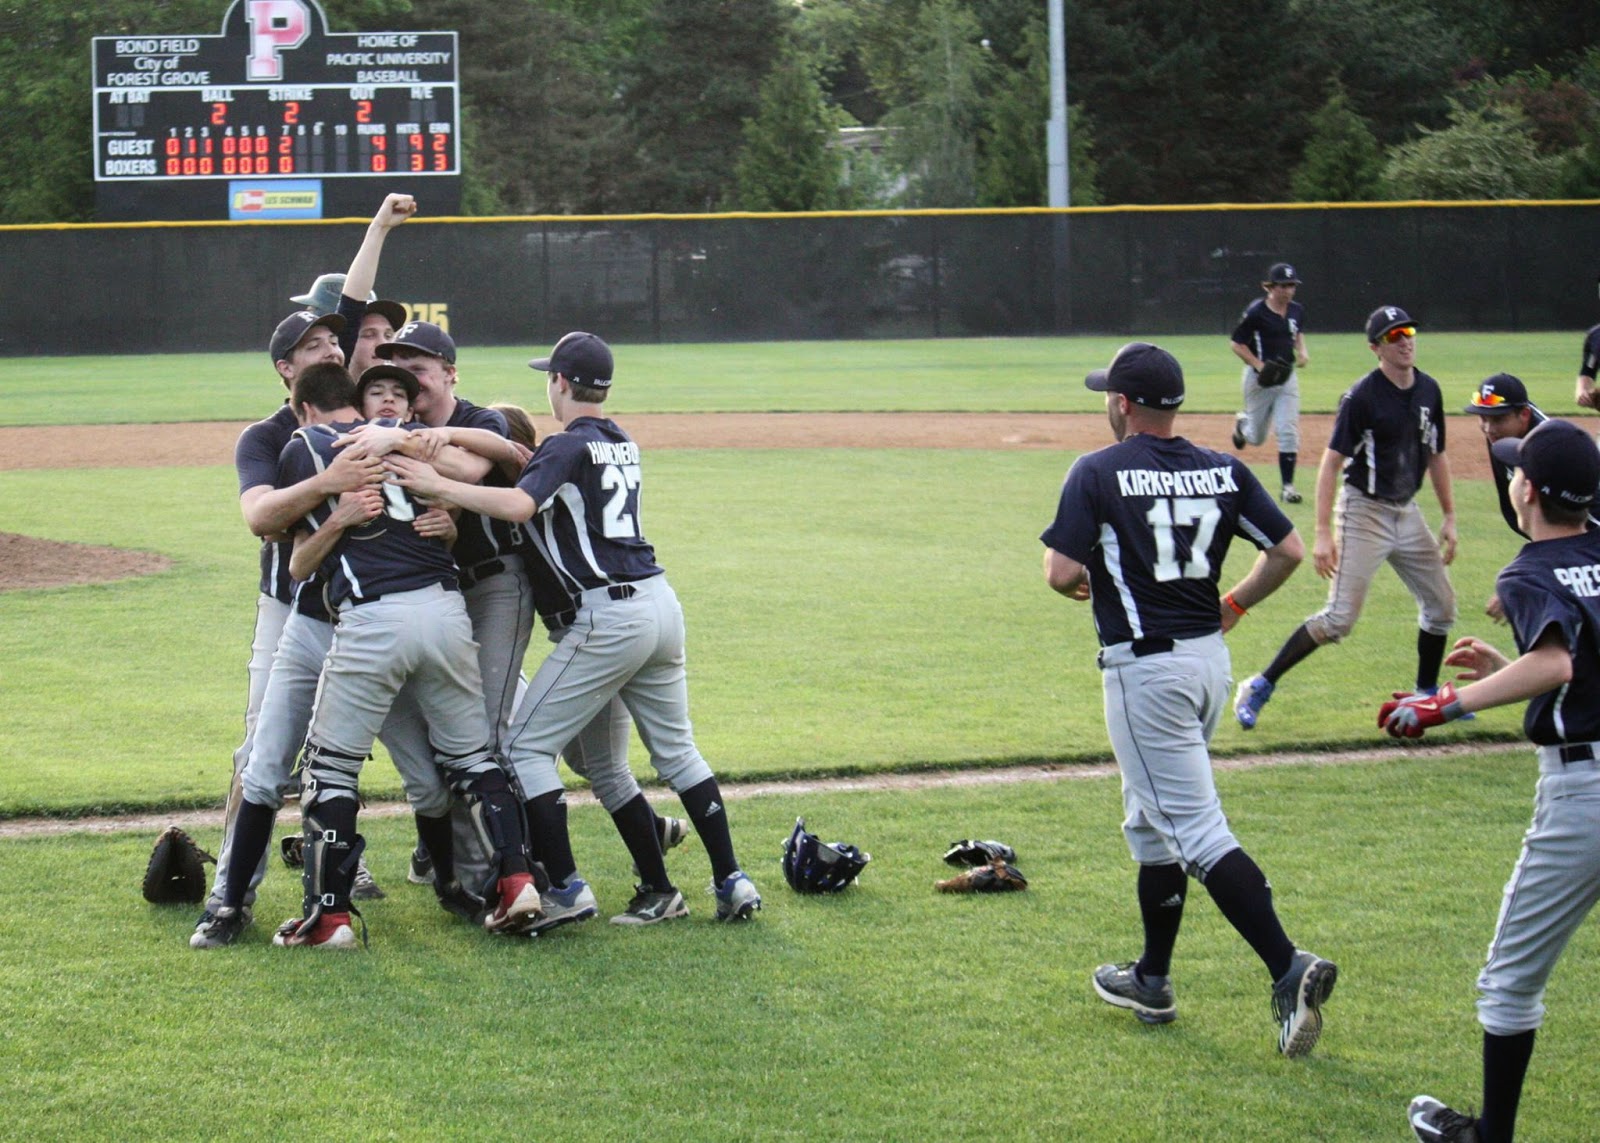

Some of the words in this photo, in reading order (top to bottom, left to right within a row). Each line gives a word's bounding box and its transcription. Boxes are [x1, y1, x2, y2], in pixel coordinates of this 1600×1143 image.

[115, 40, 159, 54] BOND
[160, 39, 199, 53] FIELD
[245, 0, 311, 81] P
[357, 35, 399, 48] HOME
[399, 35, 418, 48] OF
[134, 57, 162, 72] City
[163, 56, 180, 69] of
[326, 53, 375, 66] PACIFIC
[376, 52, 450, 65] UNIVERSITY
[107, 72, 160, 86] FOREST
[161, 71, 210, 85] GROVE
[357, 70, 421, 83] BASEBALL
[109, 91, 125, 104] AT
[127, 90, 151, 104] BAT
[201, 89, 235, 102] BALL
[268, 88, 314, 101] STRIKE
[350, 87, 375, 101] OUT
[211, 102, 228, 125] 2
[283, 101, 300, 124] 2
[356, 100, 373, 123] 2
[184, 126, 194, 138] 2
[200, 126, 209, 138] 3
[224, 125, 233, 137] 4
[241, 125, 249, 136] 5
[256, 125, 266, 136] 6
[357, 123, 386, 135] RUNS
[396, 122, 420, 134] HITS
[107, 139, 155, 156] GUEST
[278, 135, 293, 154] 2
[371, 135, 387, 151] 4
[409, 133, 424, 150] 9
[432, 133, 448, 152] 2
[105, 159, 158, 176] BOXERS
[278, 155, 294, 174] 0
[371, 154, 387, 172] 0
[410, 153, 424, 171] 3
[434, 153, 448, 171] 3
[1384, 308, 1398, 321] F
[400, 323, 418, 339] F
[1116, 466, 1239, 497] KIRKPATRICK
[601, 465, 643, 538] 27
[1146, 497, 1222, 583] 17
